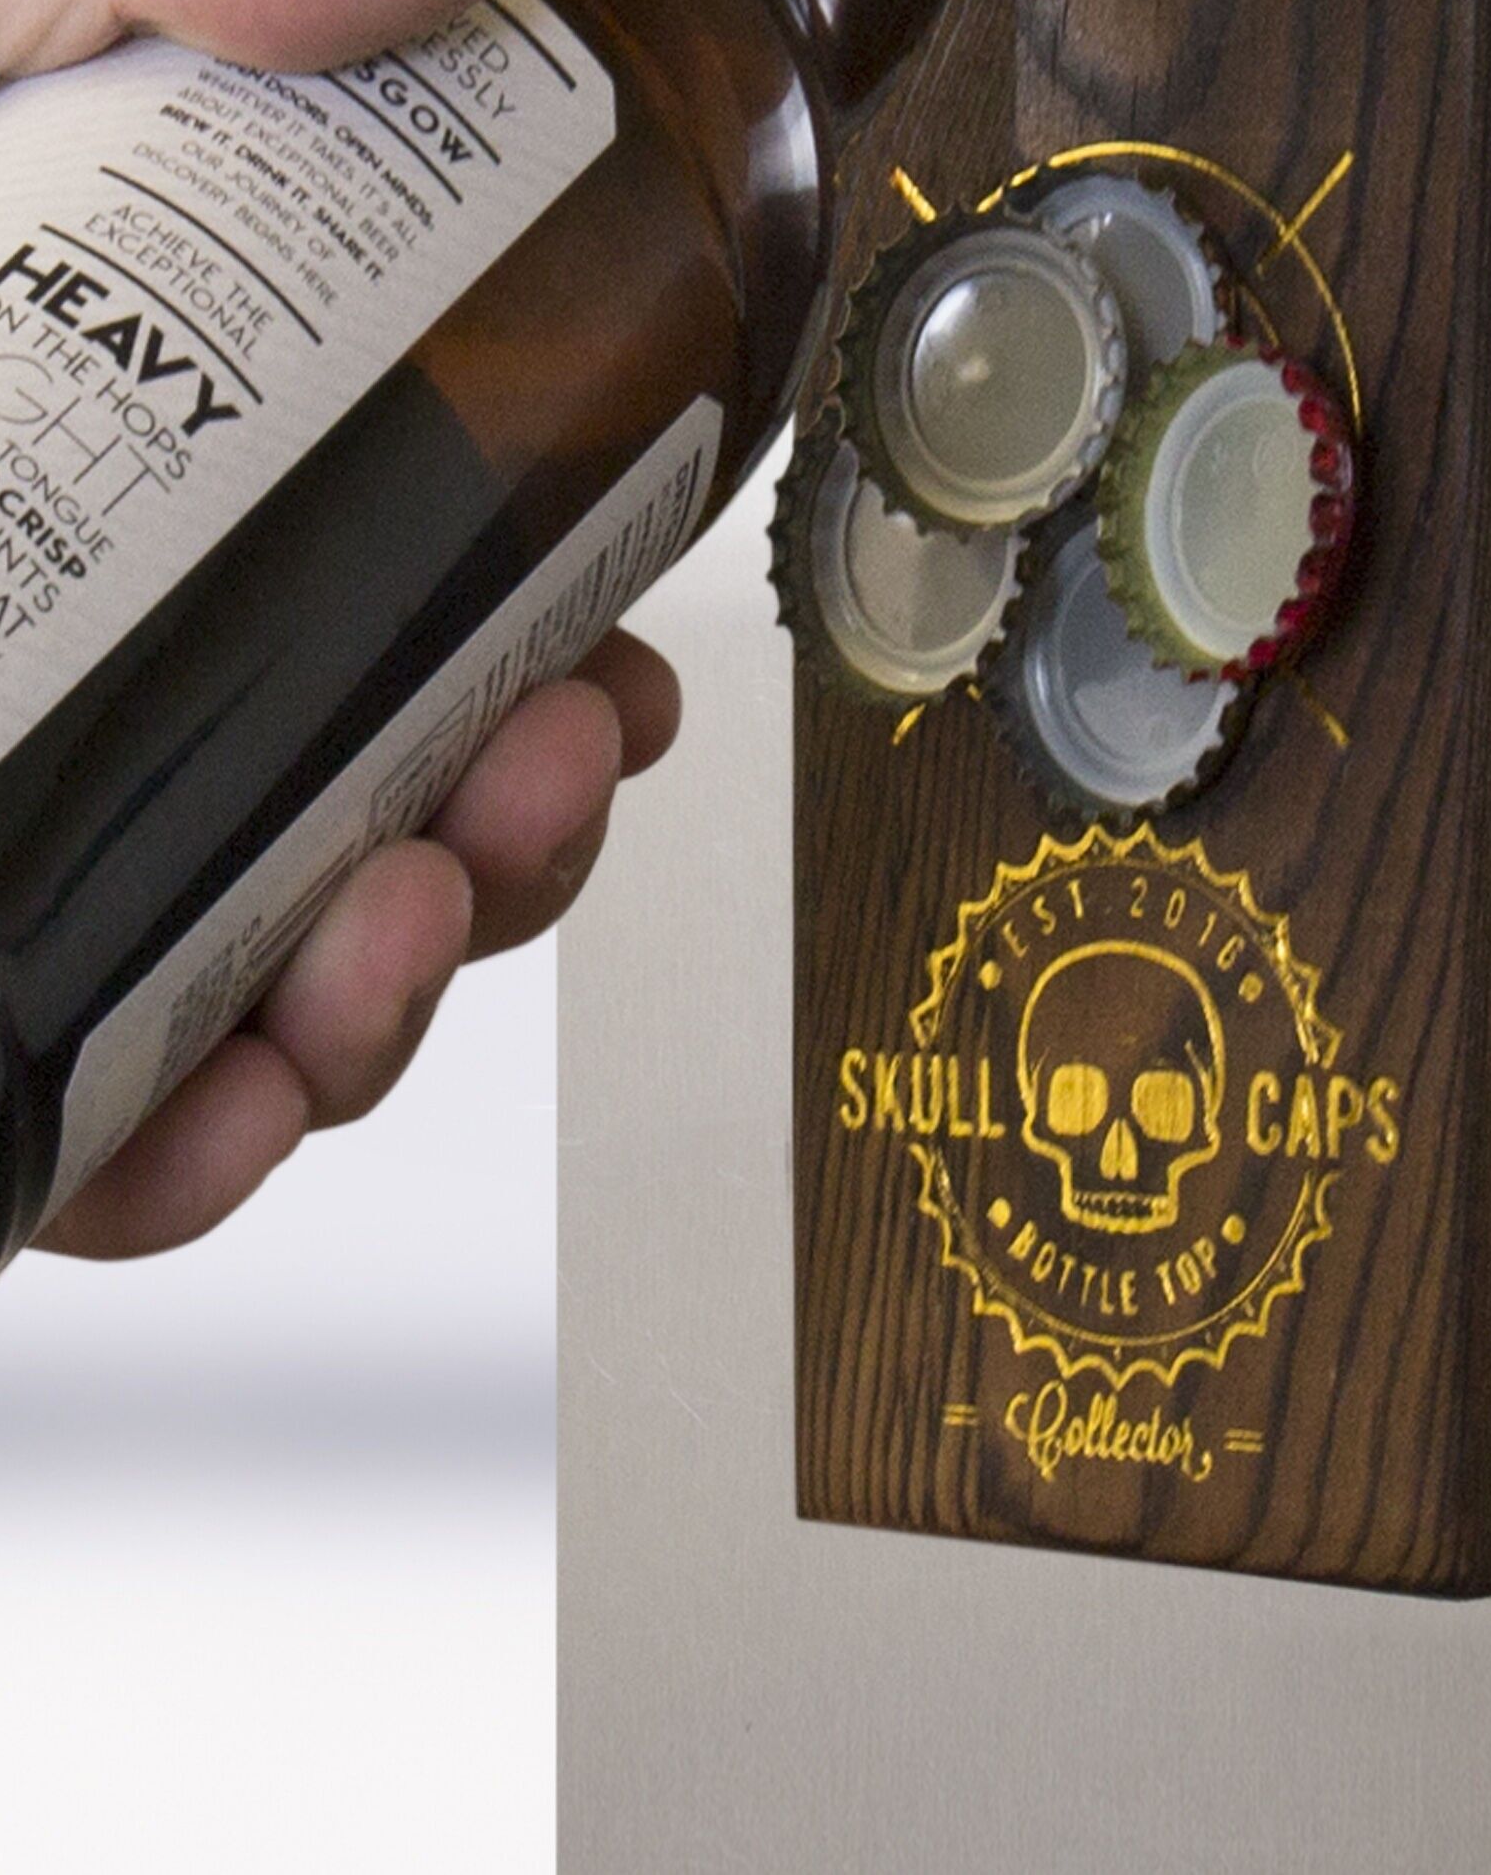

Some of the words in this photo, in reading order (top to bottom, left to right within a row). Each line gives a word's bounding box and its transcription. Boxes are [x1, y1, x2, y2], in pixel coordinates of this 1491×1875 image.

[413, 29, 516, 120] ESSLY
[448, 14, 510, 74] VED
[198, 68, 286, 123] WHATEVER
[286, 119, 306, 137] IT
[391, 219, 418, 249] ALL
[334, 125, 384, 170] OPEN
[355, 58, 474, 164] SGOW
[132, 140, 235, 207] DISCOVERY
[233, 202, 295, 263] BEGINS
[296, 260, 339, 307] HERE
[160, 103, 212, 134] BREW
[235, 143, 292, 189] DRINK
[313, 205, 368, 267] SHARE
[177, 86, 243, 123] ABOUT
[243, 119, 355, 219] EXCEPTIONAL
[358, 216, 401, 265] BEER
[182, 140, 225, 171] OUR
[225, 169, 306, 235] JOURNEY
[308, 235, 336, 262] OF
[84, 212, 260, 363] EXCEPTIONAL
[111, 203, 224, 280] ACHIEVE
[225, 281, 275, 331] THE
[33, 322, 103, 386] THE
[95, 377, 193, 480] HOPS
[0, 439, 115, 565] TONGUE
[1001, 878, 1086, 958] EST
[839, 1047, 1005, 1139] SKULL
[1246, 1068, 1403, 1165] CAPS
[1007, 1220, 1139, 1317] BOTTLE
[1155, 1235, 1217, 1306] TOP
[1004, 1378, 1214, 1483] Collector
